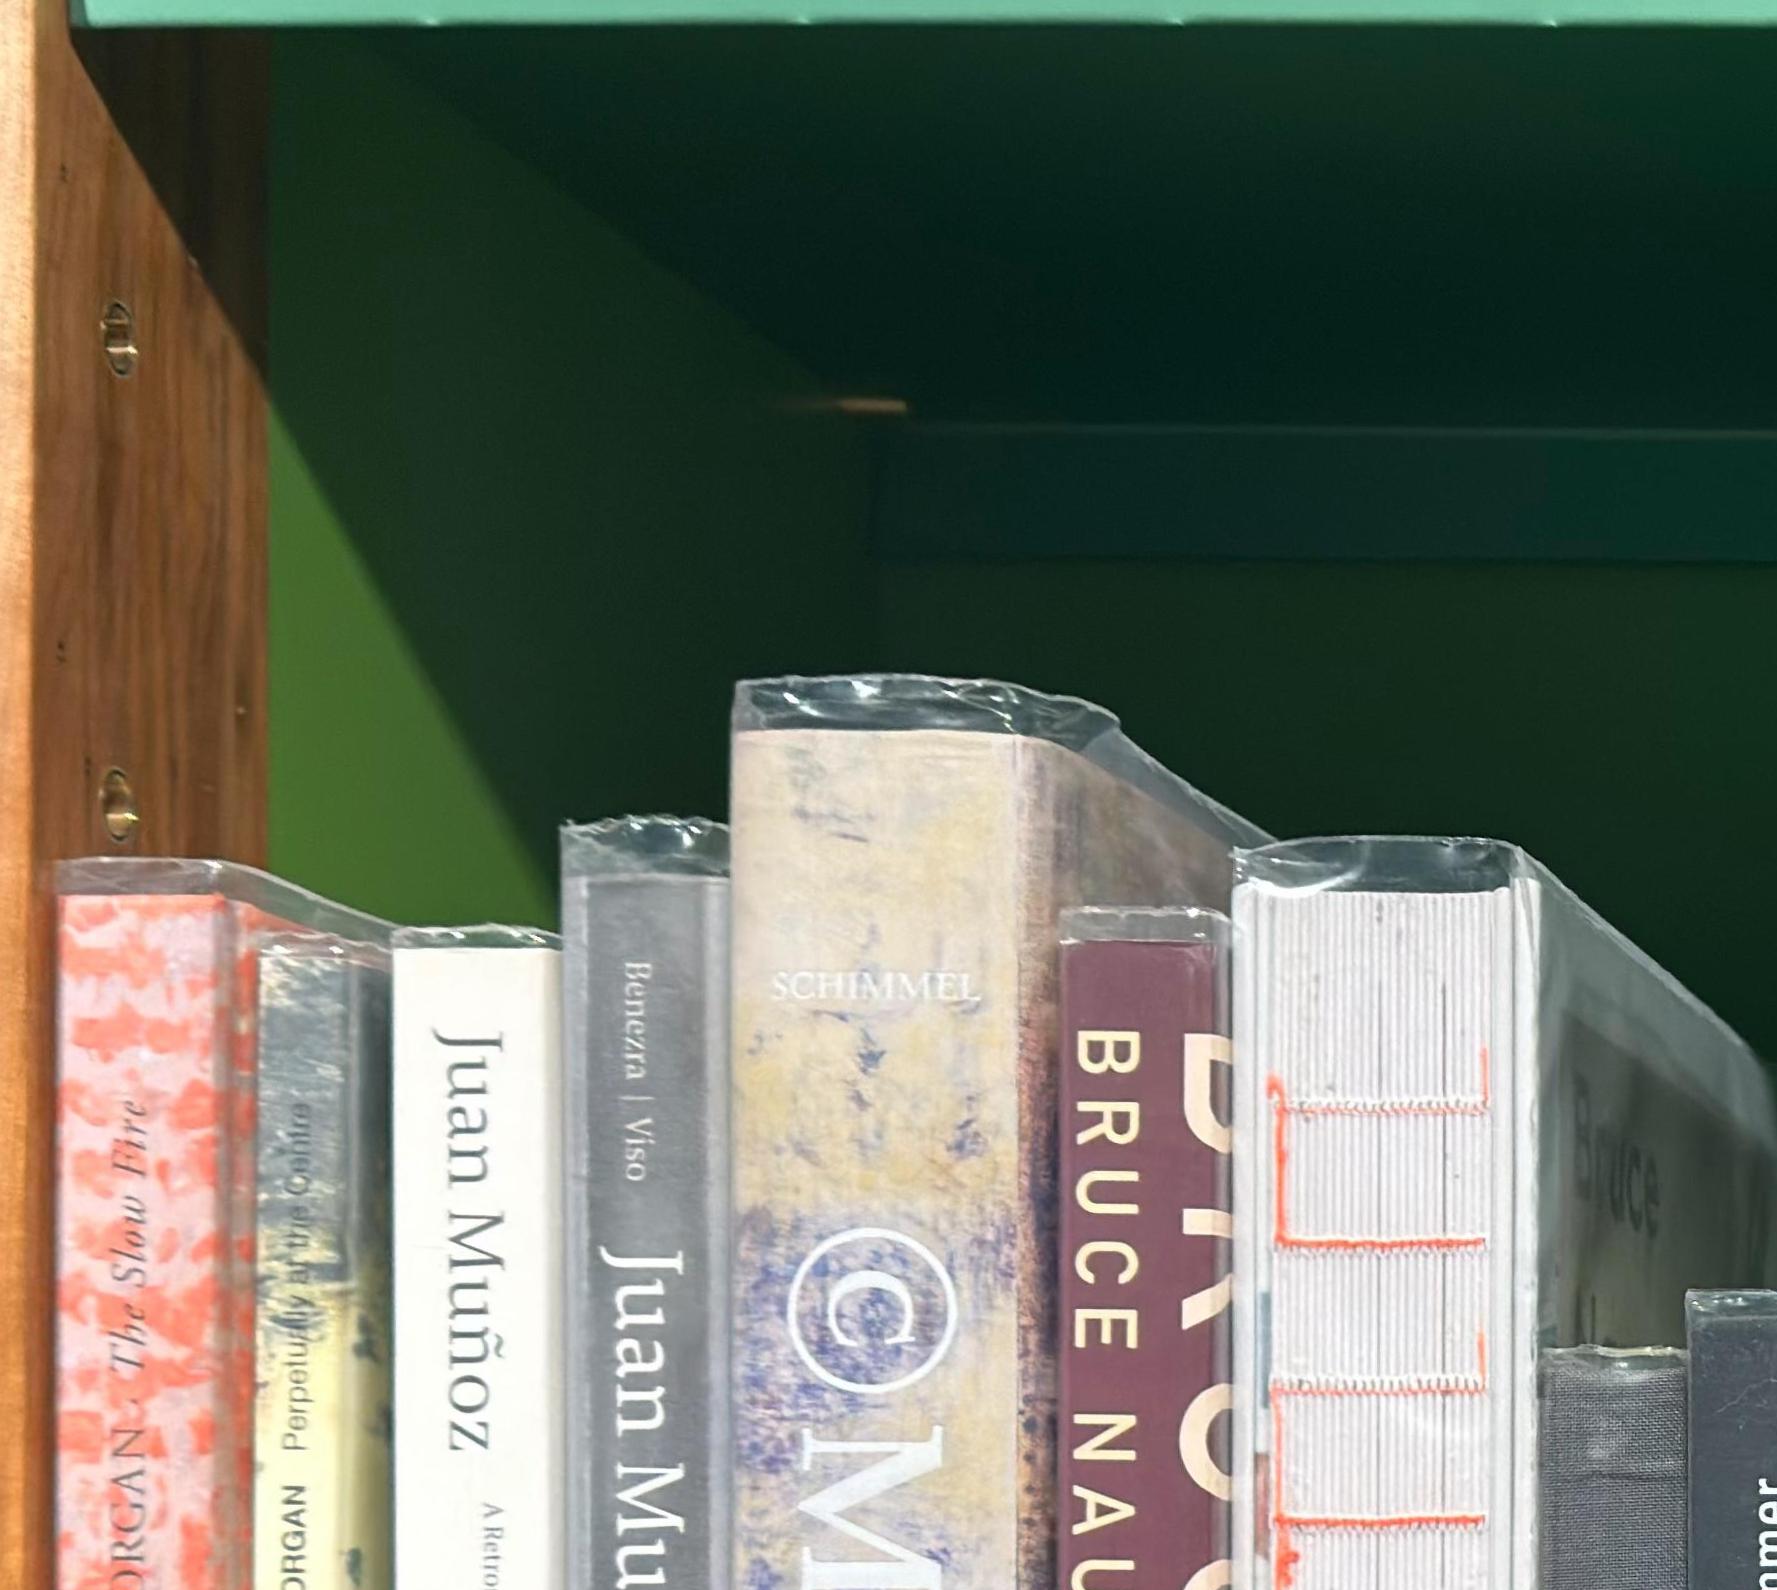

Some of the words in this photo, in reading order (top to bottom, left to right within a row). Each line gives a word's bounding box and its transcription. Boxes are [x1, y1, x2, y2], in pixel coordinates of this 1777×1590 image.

[624, 961, 652, 1080] Benezra
[771, 971, 980, 1001] SCHIMMEL
[111, 1099, 147, 1178] Fire
[431, 1028, 502, 1188] Juan
[625, 1117, 653, 1183] Viso
[1074, 1029, 1139, 1349] BRUCE
[111, 1199, 147, 1289] Slow
[111, 1305, 147, 1372] The
[448, 1209, 504, 1452] Muñoz
[600, 1247, 683, 1436] Juan
[482, 1503, 504, 1519] A
